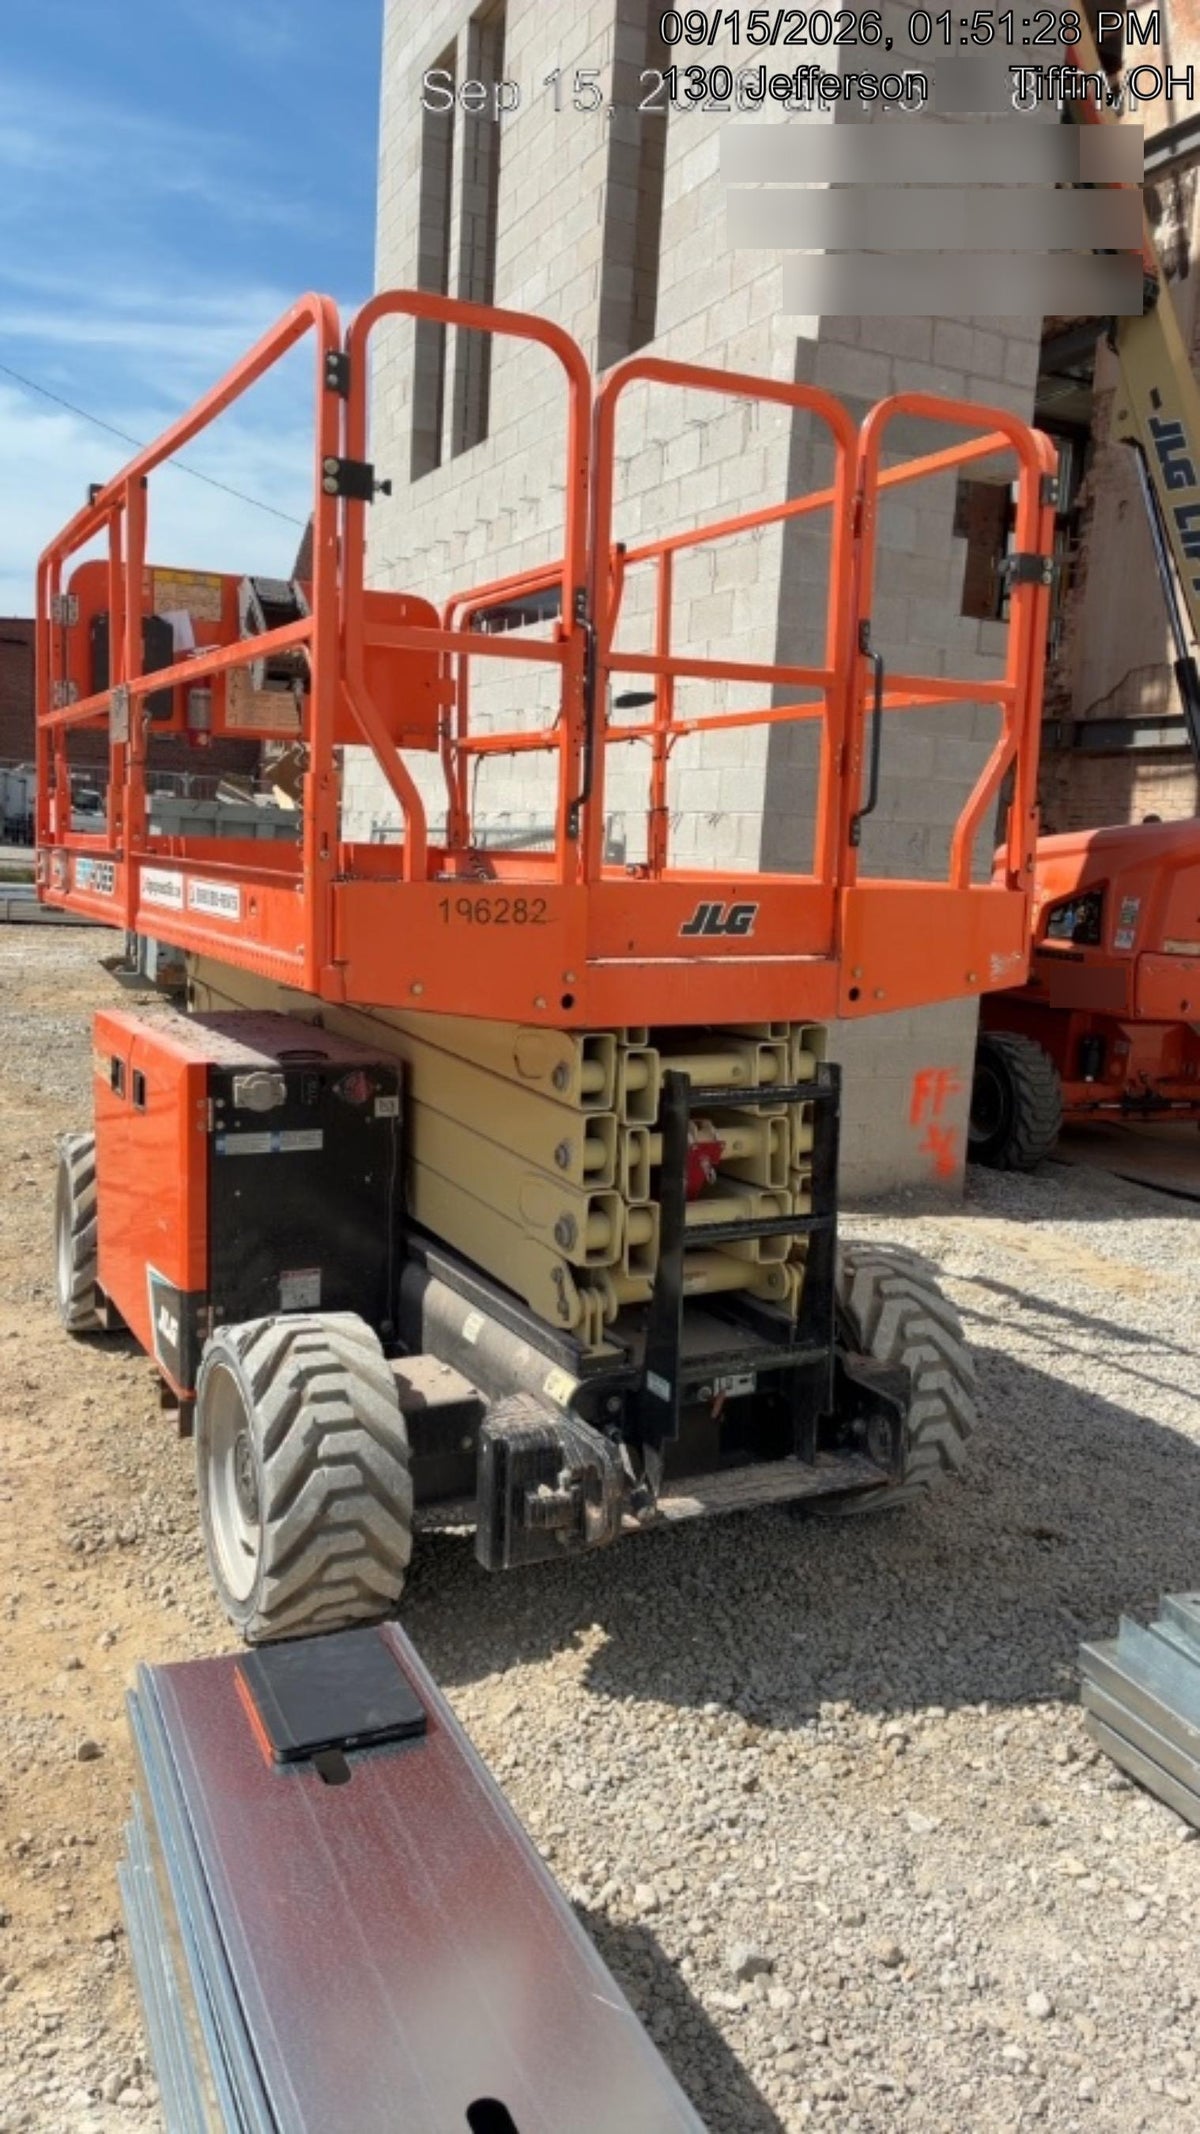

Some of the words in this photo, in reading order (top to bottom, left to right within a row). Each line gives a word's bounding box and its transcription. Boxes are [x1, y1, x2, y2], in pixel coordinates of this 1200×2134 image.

[1148, 416, 1197, 490] JLG
[438, 898, 548, 925] 196282
[679, 902, 758, 937] JLG
